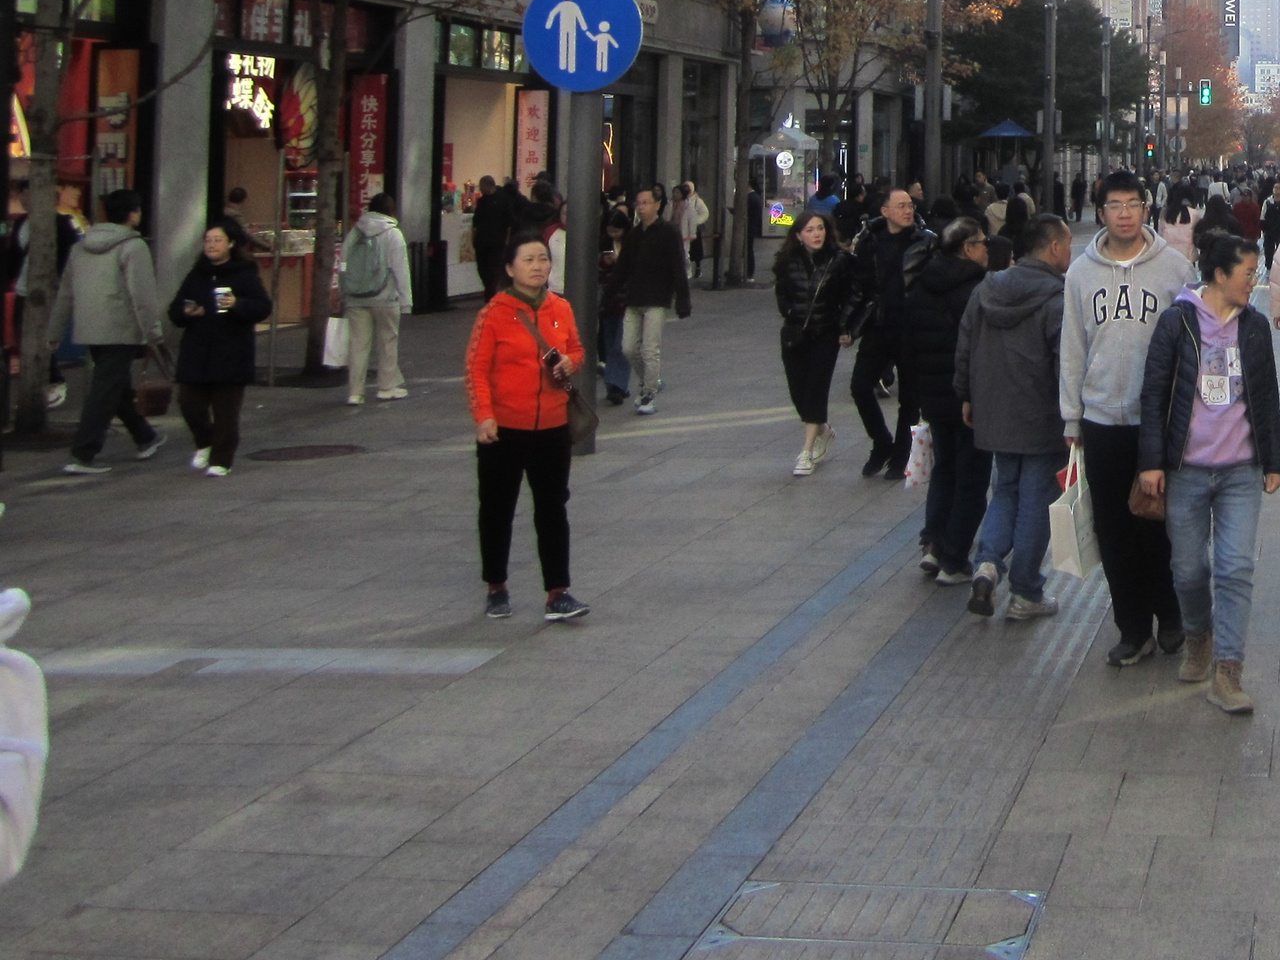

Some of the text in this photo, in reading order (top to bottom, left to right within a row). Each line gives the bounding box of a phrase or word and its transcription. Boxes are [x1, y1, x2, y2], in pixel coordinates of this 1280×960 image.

[226, 77, 275, 129] 蝶酥
[359, 94, 379, 213] 快乐分享
[1092, 283, 1160, 327] GAP
